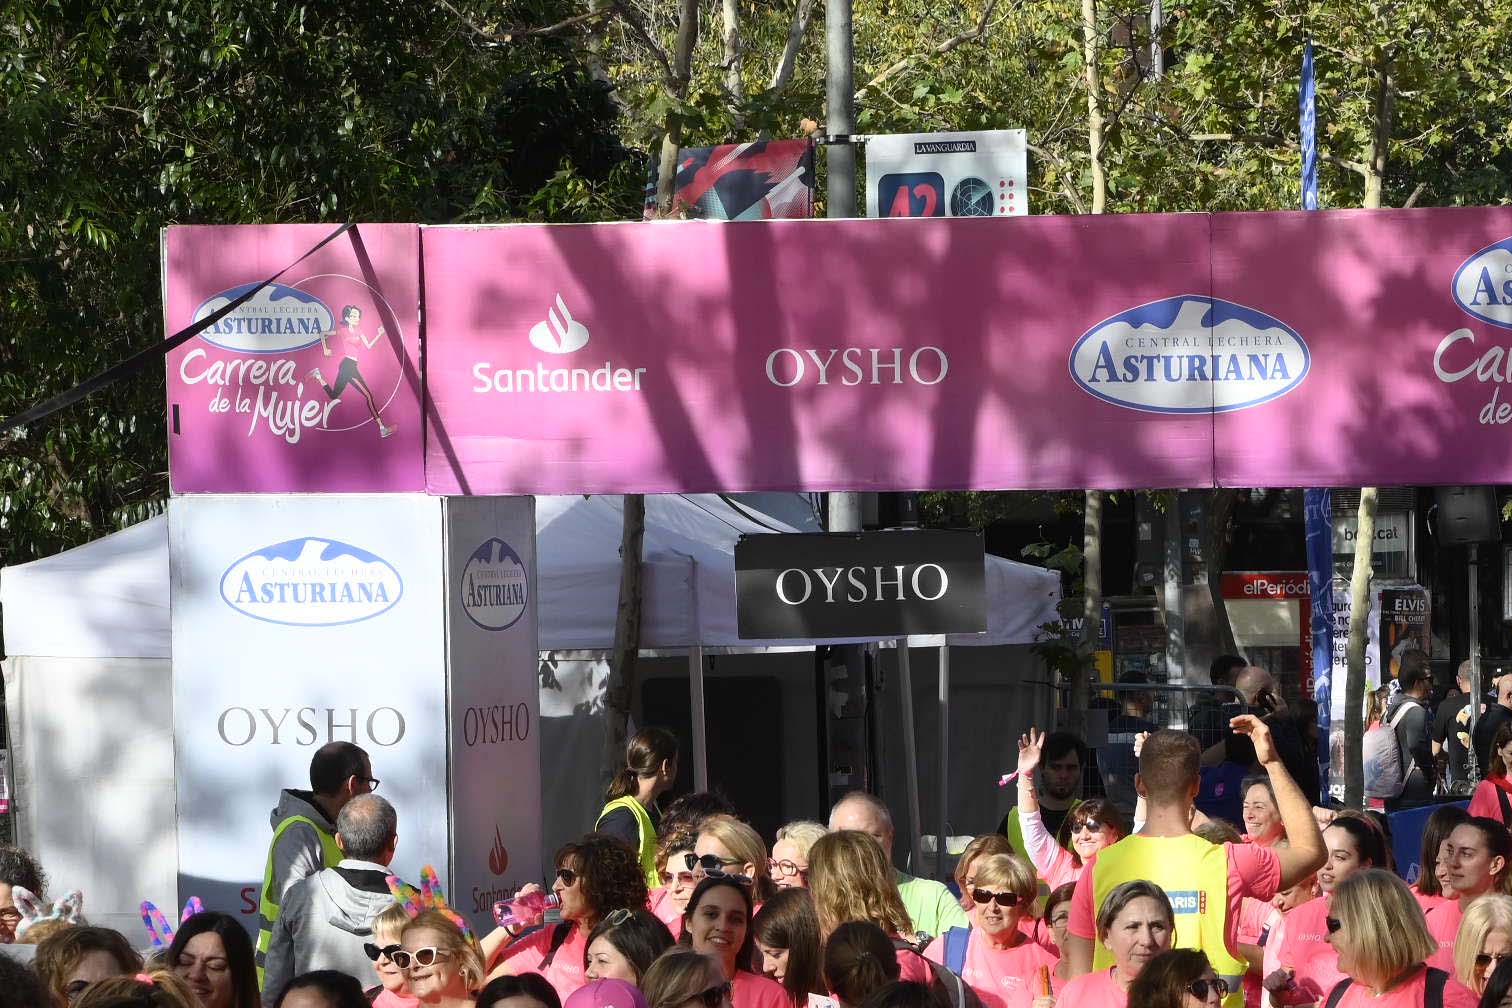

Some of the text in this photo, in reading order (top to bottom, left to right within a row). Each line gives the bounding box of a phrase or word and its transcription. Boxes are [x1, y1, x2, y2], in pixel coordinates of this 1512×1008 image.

[203, 308, 323, 336] ASTURIANA
[1125, 334, 1283, 348] CENTRAL LECHERA
[180, 348, 296, 385] Carrera
[473, 362, 646, 393] Santander
[765, 345, 949, 388] OYSHO
[1089, 340, 1290, 385] ASTURIANA
[209, 384, 341, 443] de la Mujer
[1479, 388, 1512, 425] de
[235, 571, 392, 604] ASTURIANA
[466, 573, 524, 607] ASTURIANA
[775, 562, 950, 602] OYSHO
[217, 707, 405, 746] OYSHO
[463, 702, 529, 746] OYSHO
